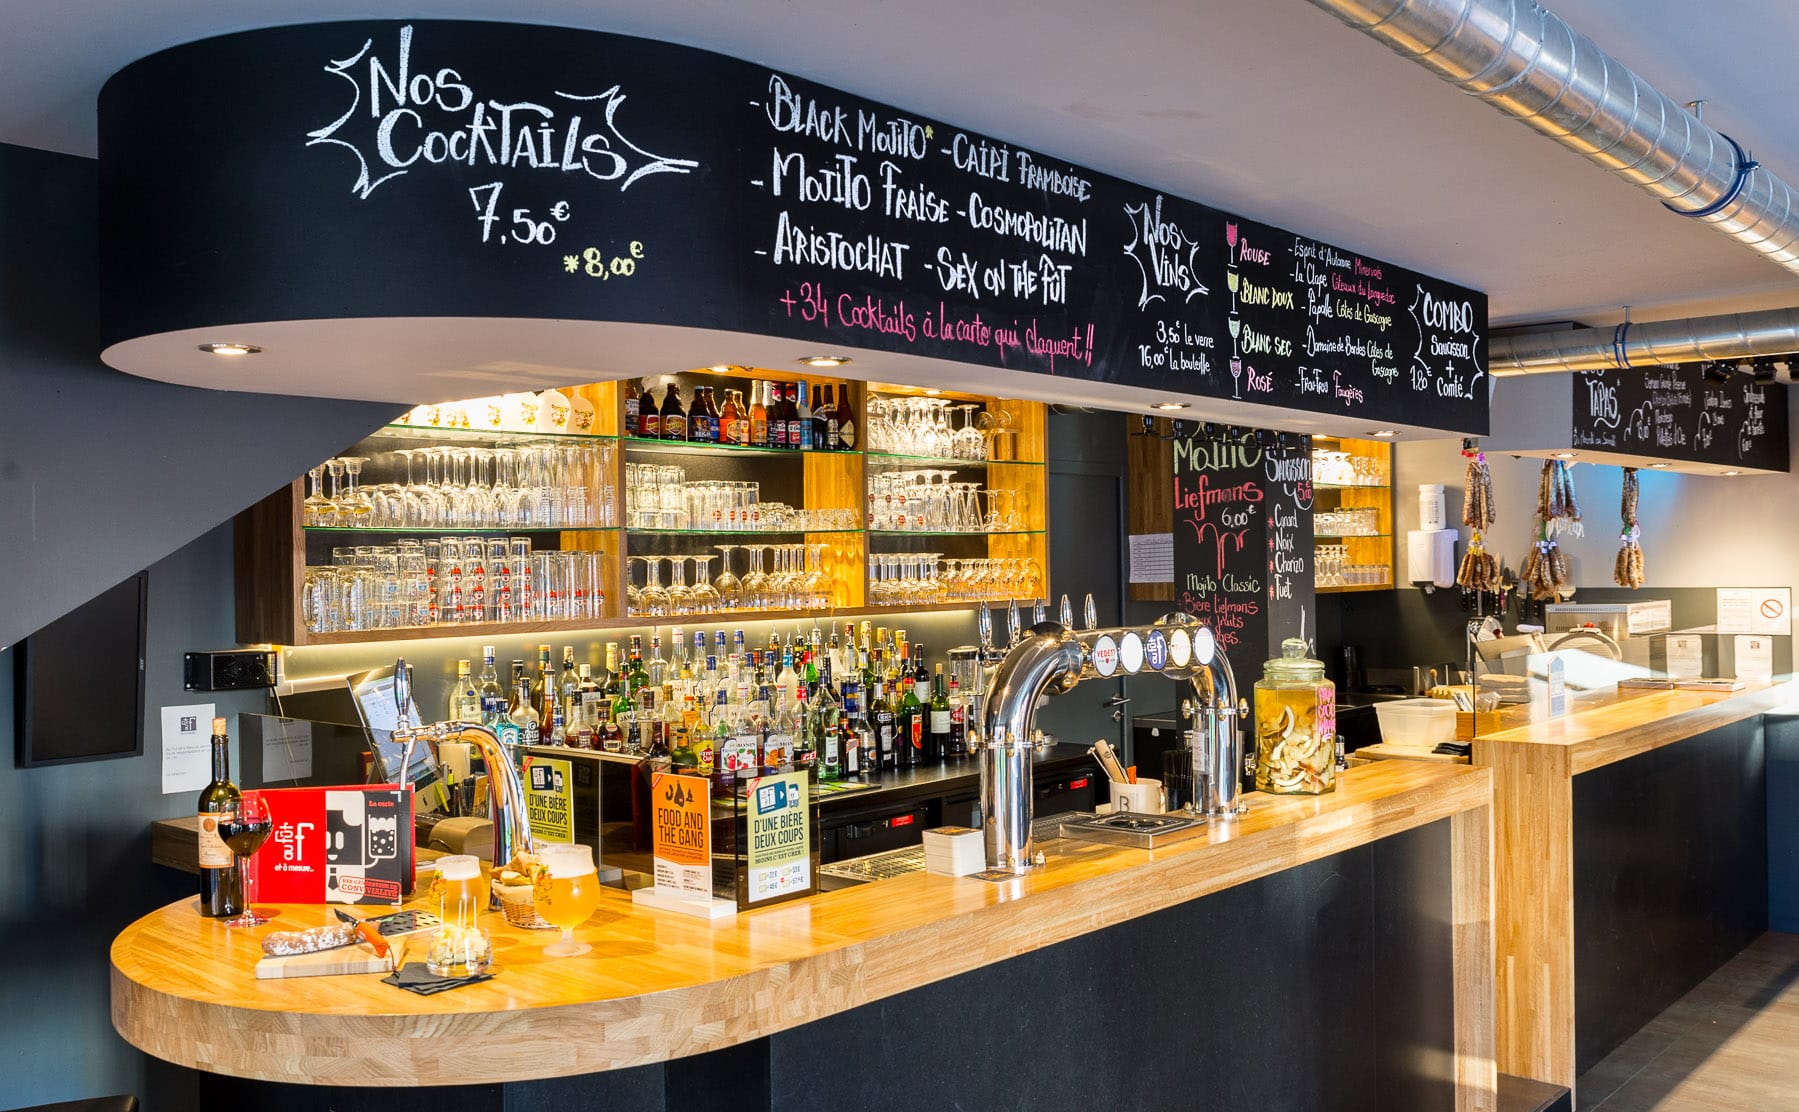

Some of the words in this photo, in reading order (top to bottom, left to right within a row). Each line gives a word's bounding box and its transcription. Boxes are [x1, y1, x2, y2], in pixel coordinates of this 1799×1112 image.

[766, 74, 852, 147] BLACK
[1240, 237, 1272, 266] ROUGE
[1294, 238, 1316, 268] Esprit
[937, 247, 979, 299] SEX
[984, 260, 1006, 296] ON
[1009, 260, 1037, 298] THE
[1306, 262, 1327, 297] Clape
[1358, 281, 1365, 296] du
[1367, 282, 1395, 307] Languedoc
[1240, 277, 1270, 305] BLANC
[1272, 287, 1294, 310] DOUX
[838, 293, 916, 342] Cocktails
[923, 311, 936, 337] à
[940, 301, 954, 340] la
[957, 314, 991, 346] carte
[995, 320, 1019, 359] qui
[1354, 304, 1362, 321] de
[1364, 305, 1392, 332] Gascogne
[1423, 292, 1474, 334] COMBO
[1195, 334, 1214, 348] verre
[1242, 324, 1272, 353] BLANC
[1275, 336, 1293, 357] SEC
[1307, 325, 1337, 357] Domaine
[1336, 338, 1344, 353] de
[1384, 344, 1393, 360] de
[1431, 336, 1470, 360] Saucisson
[1437, 377, 1464, 398] Comté
[1585, 378, 1618, 419] TAPAS
[1274, 504, 1298, 528] Canard
[1276, 532, 1295, 551] Noix
[1274, 552, 1305, 574] Chorizo
[1187, 573, 1217, 599] Mojito
[1223, 573, 1261, 593] Classic
[1274, 574, 1293, 600] Fuet
[530, 808, 546, 821] DEUX
[548, 811, 567, 825] COUPS
[659, 808, 681, 827] FOOD
[684, 812, 703, 830] AND
[754, 816, 778, 833] D'UNE
[780, 811, 803, 831] BIÈRE
[658, 825, 677, 845] THE
[679, 828, 703, 848] GANG
[754, 834, 777, 849] DEUX
[778, 828, 803, 845] COUPS
